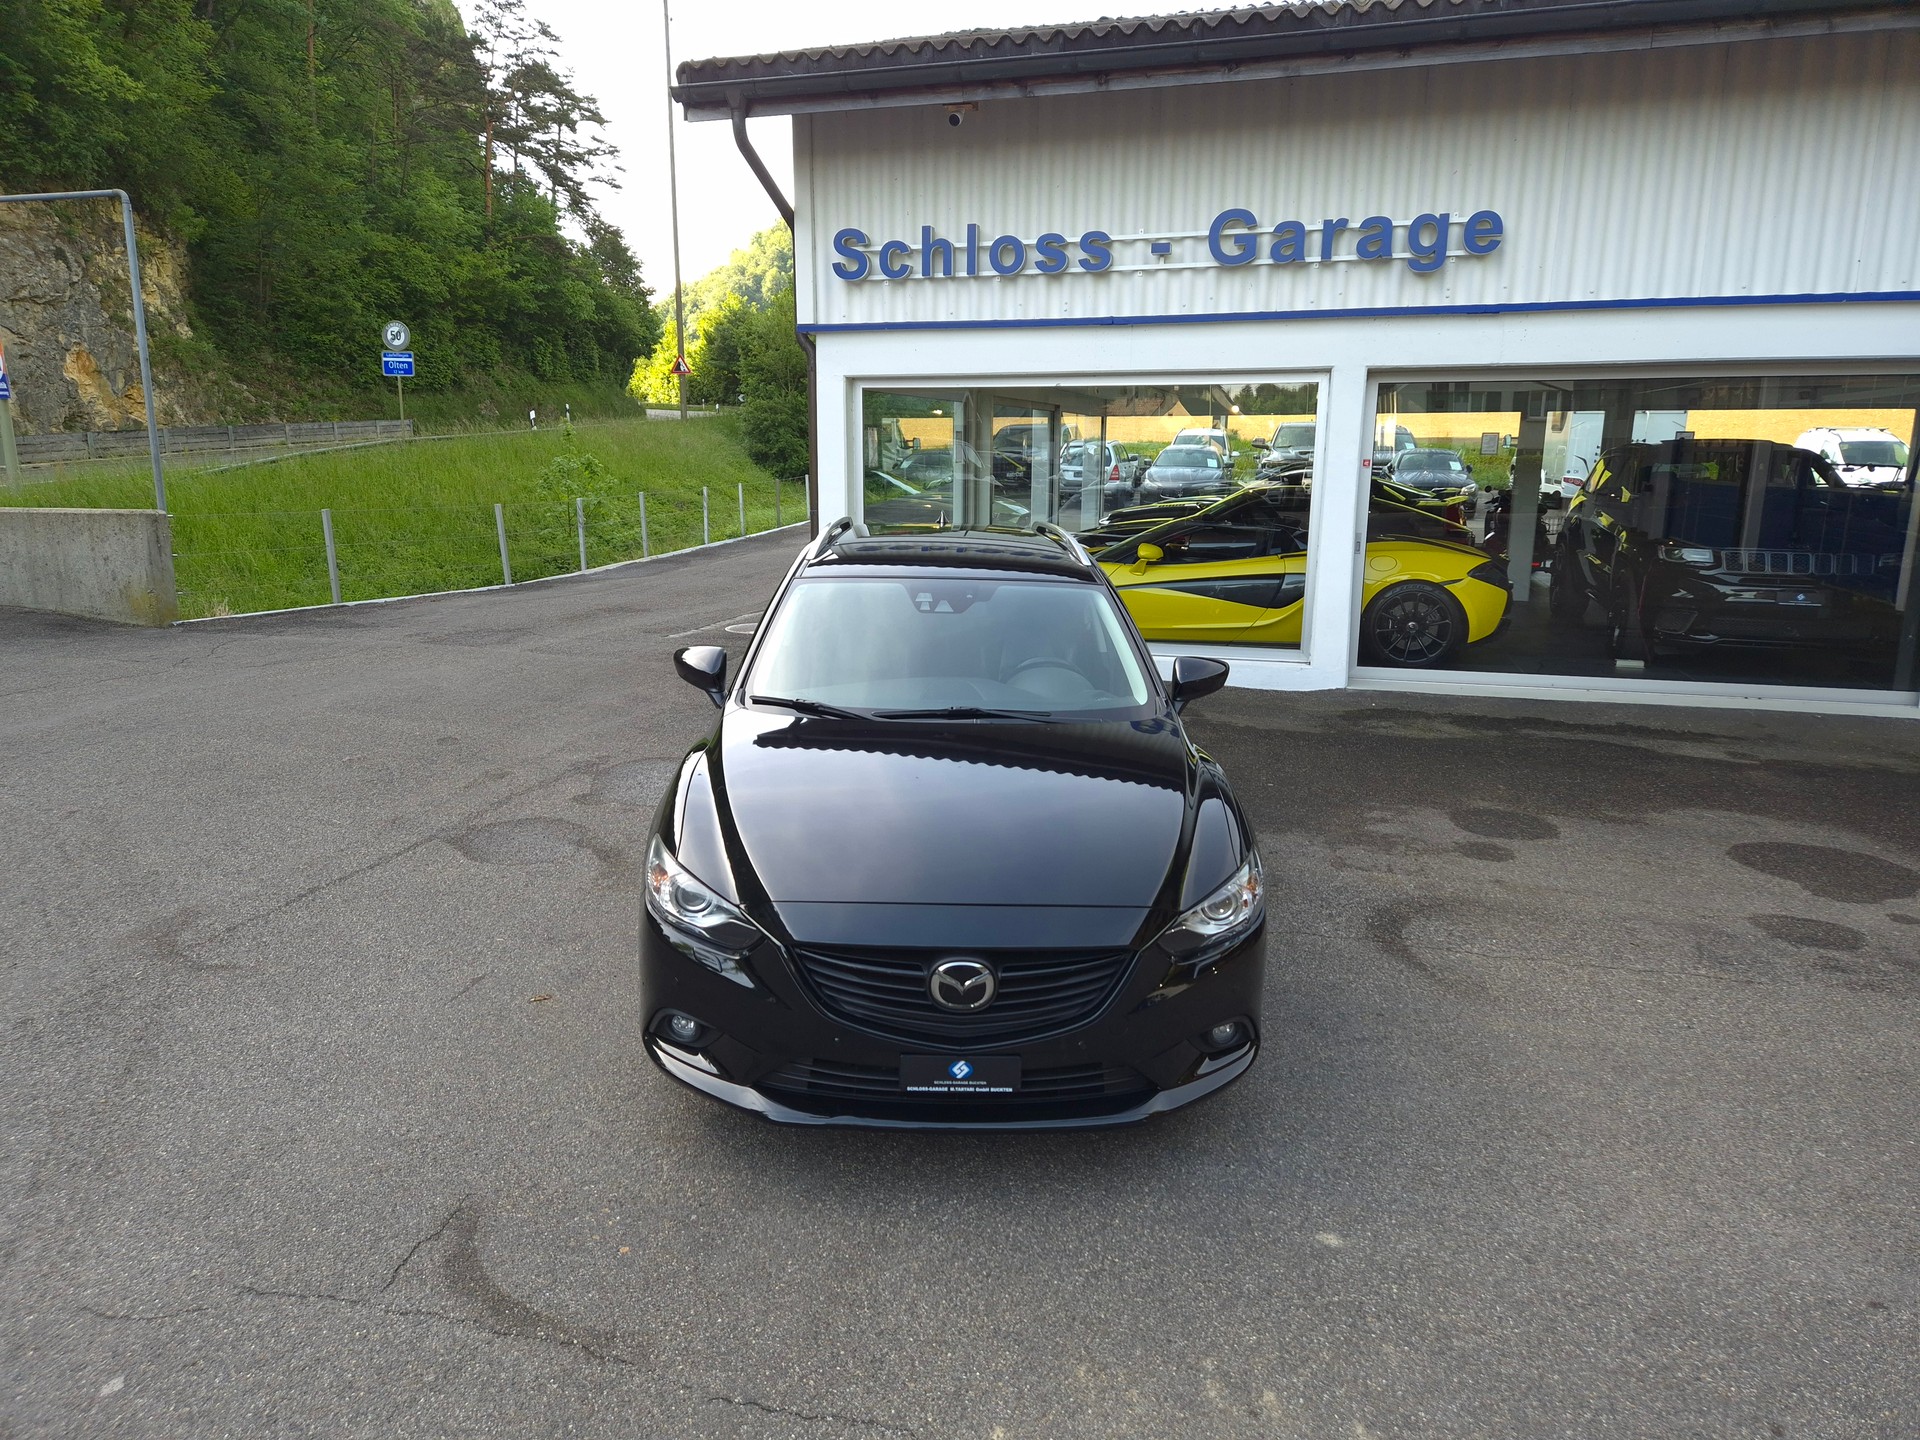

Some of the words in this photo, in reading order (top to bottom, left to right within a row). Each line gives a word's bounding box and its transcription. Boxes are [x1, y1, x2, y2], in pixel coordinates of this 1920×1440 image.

[832, 222, 1114, 281] Schloss
[1208, 207, 1503, 274] Garage
[390, 330, 401, 341] 50
[388, 361, 409, 369] Olten
